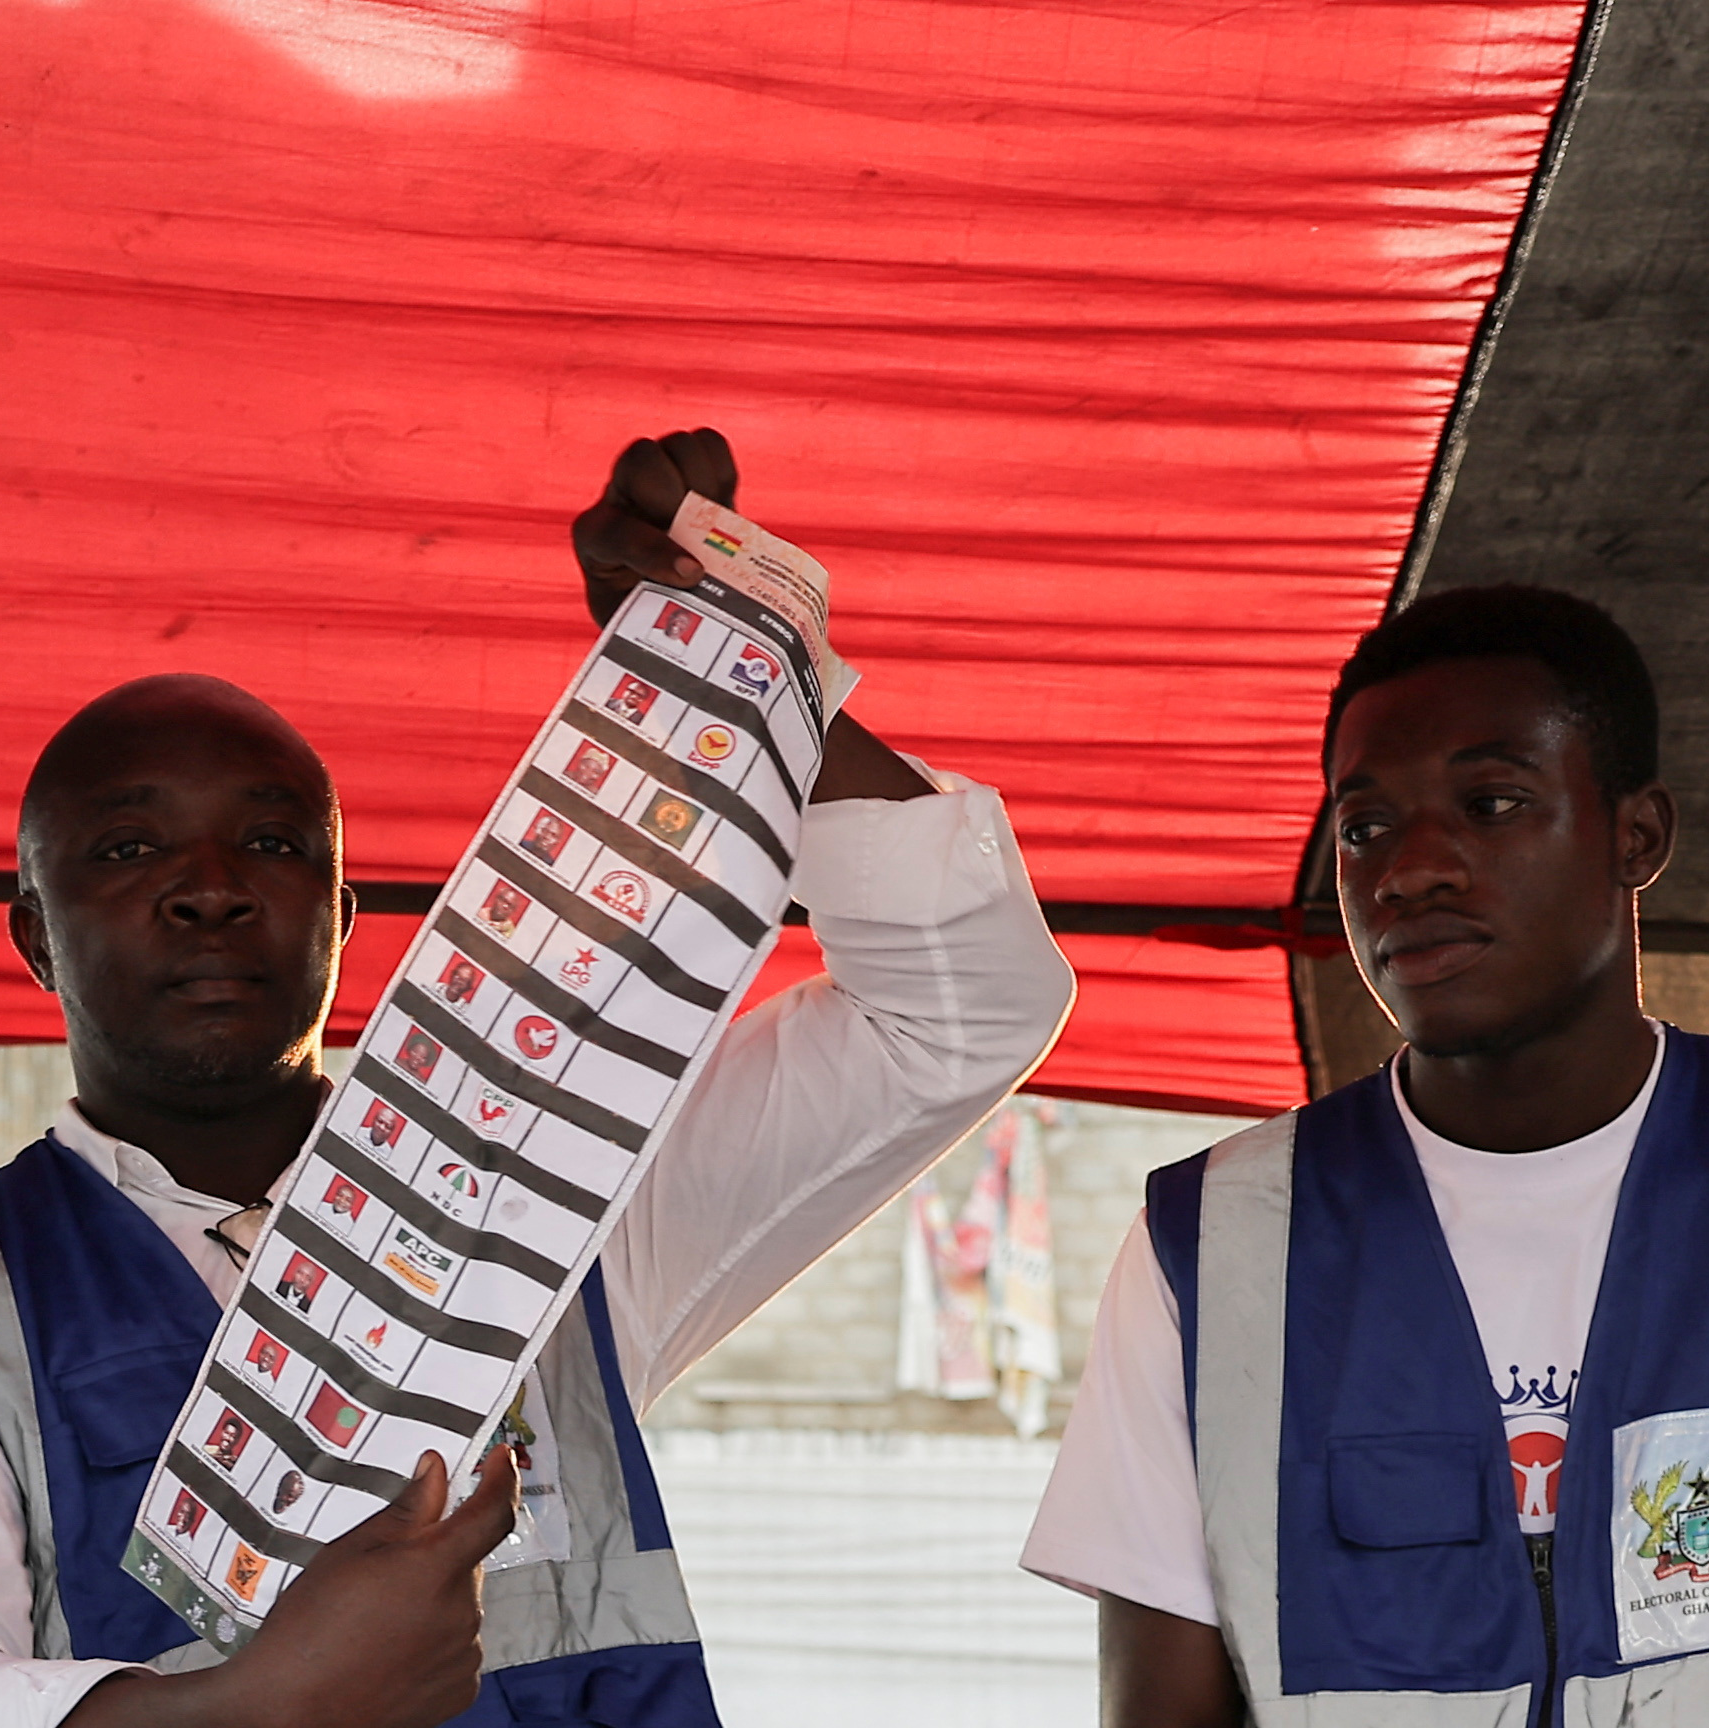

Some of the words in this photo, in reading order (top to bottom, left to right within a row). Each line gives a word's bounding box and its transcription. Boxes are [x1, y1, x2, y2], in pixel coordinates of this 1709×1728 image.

[560, 960, 593, 985] LPG
[481, 1087, 515, 1109] CPP
[403, 1237, 442, 1266] APC
[1630, 1589, 1699, 1612] ELECTORAL
